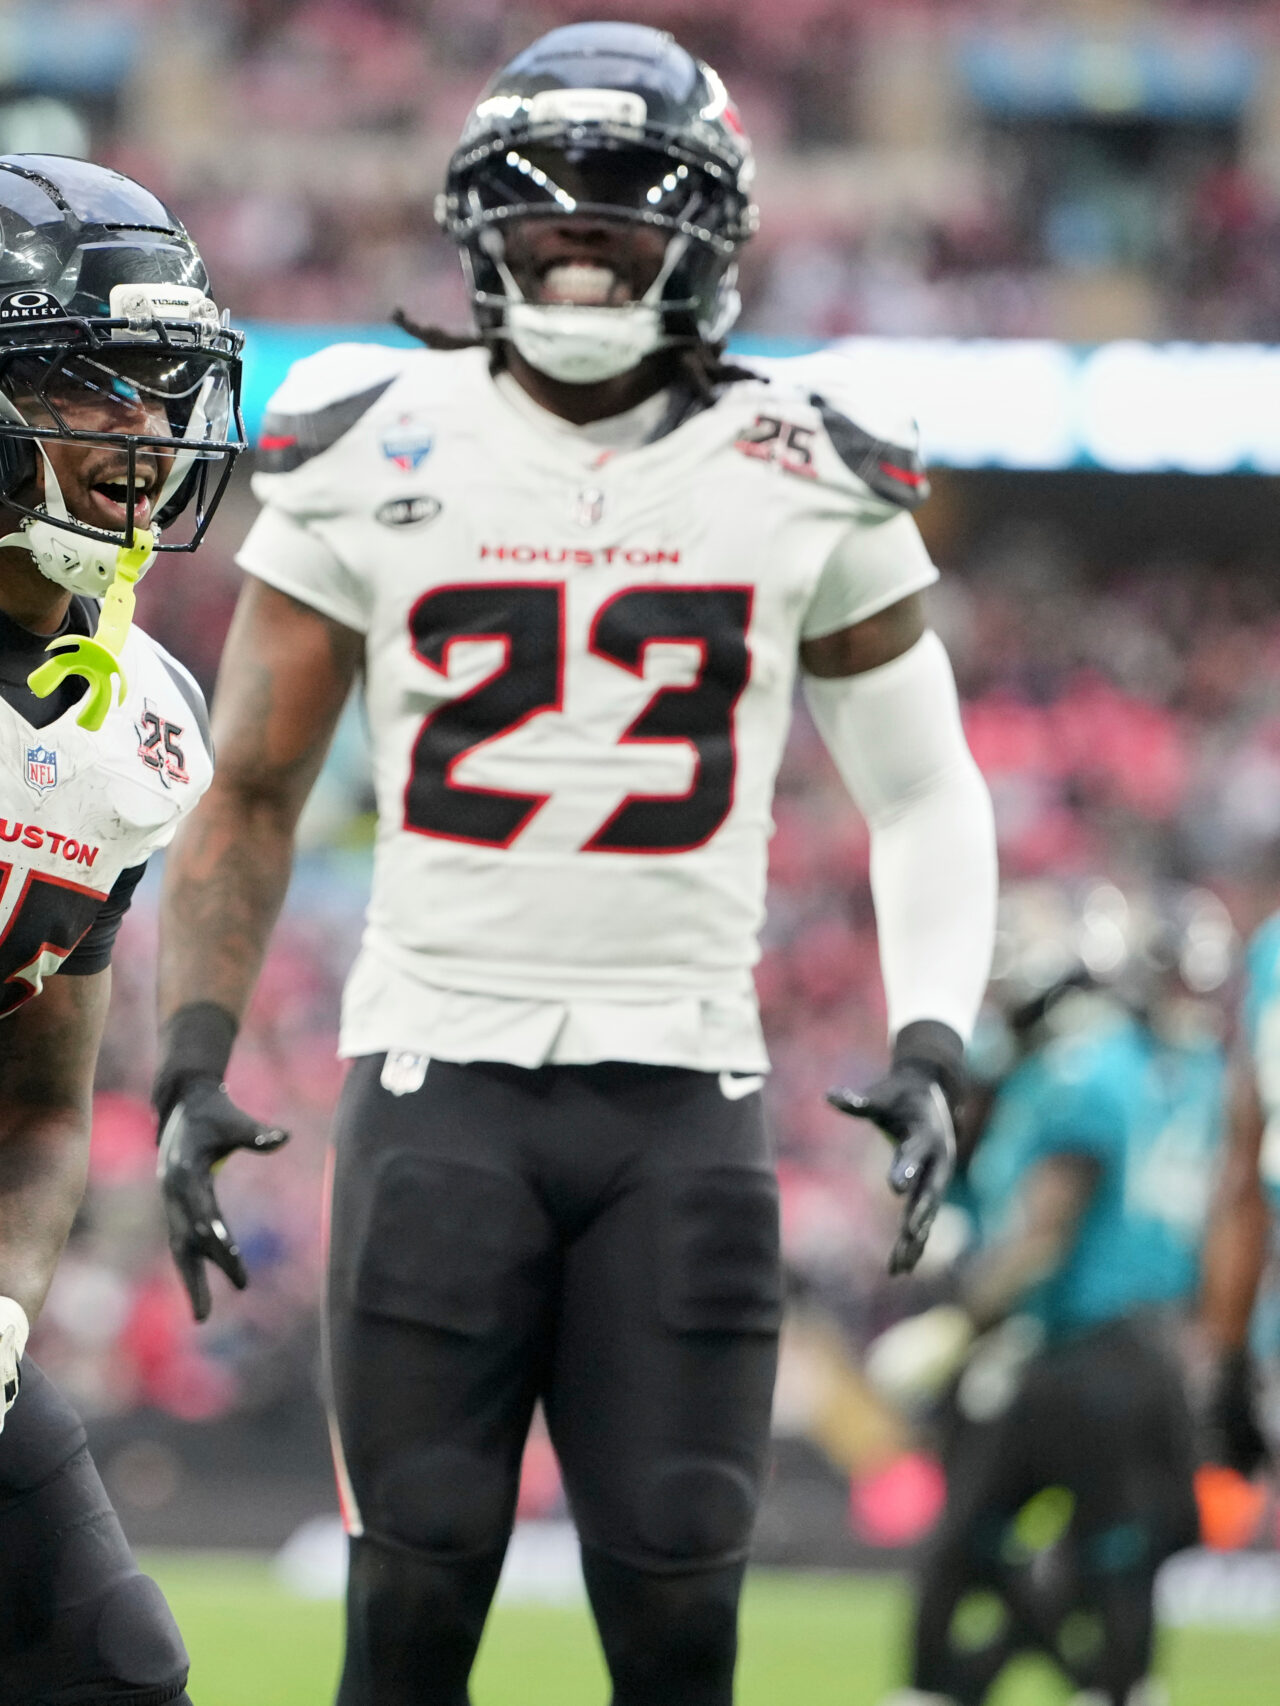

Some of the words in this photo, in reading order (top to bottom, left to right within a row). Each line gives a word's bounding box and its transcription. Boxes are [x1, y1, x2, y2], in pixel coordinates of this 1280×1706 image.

[1, 307, 59, 318] OAKLEY
[480, 545, 680, 566] HOUSTON
[403, 581, 754, 854] 23
[140, 709, 185, 780] 25
[30, 763, 54, 785] NFL
